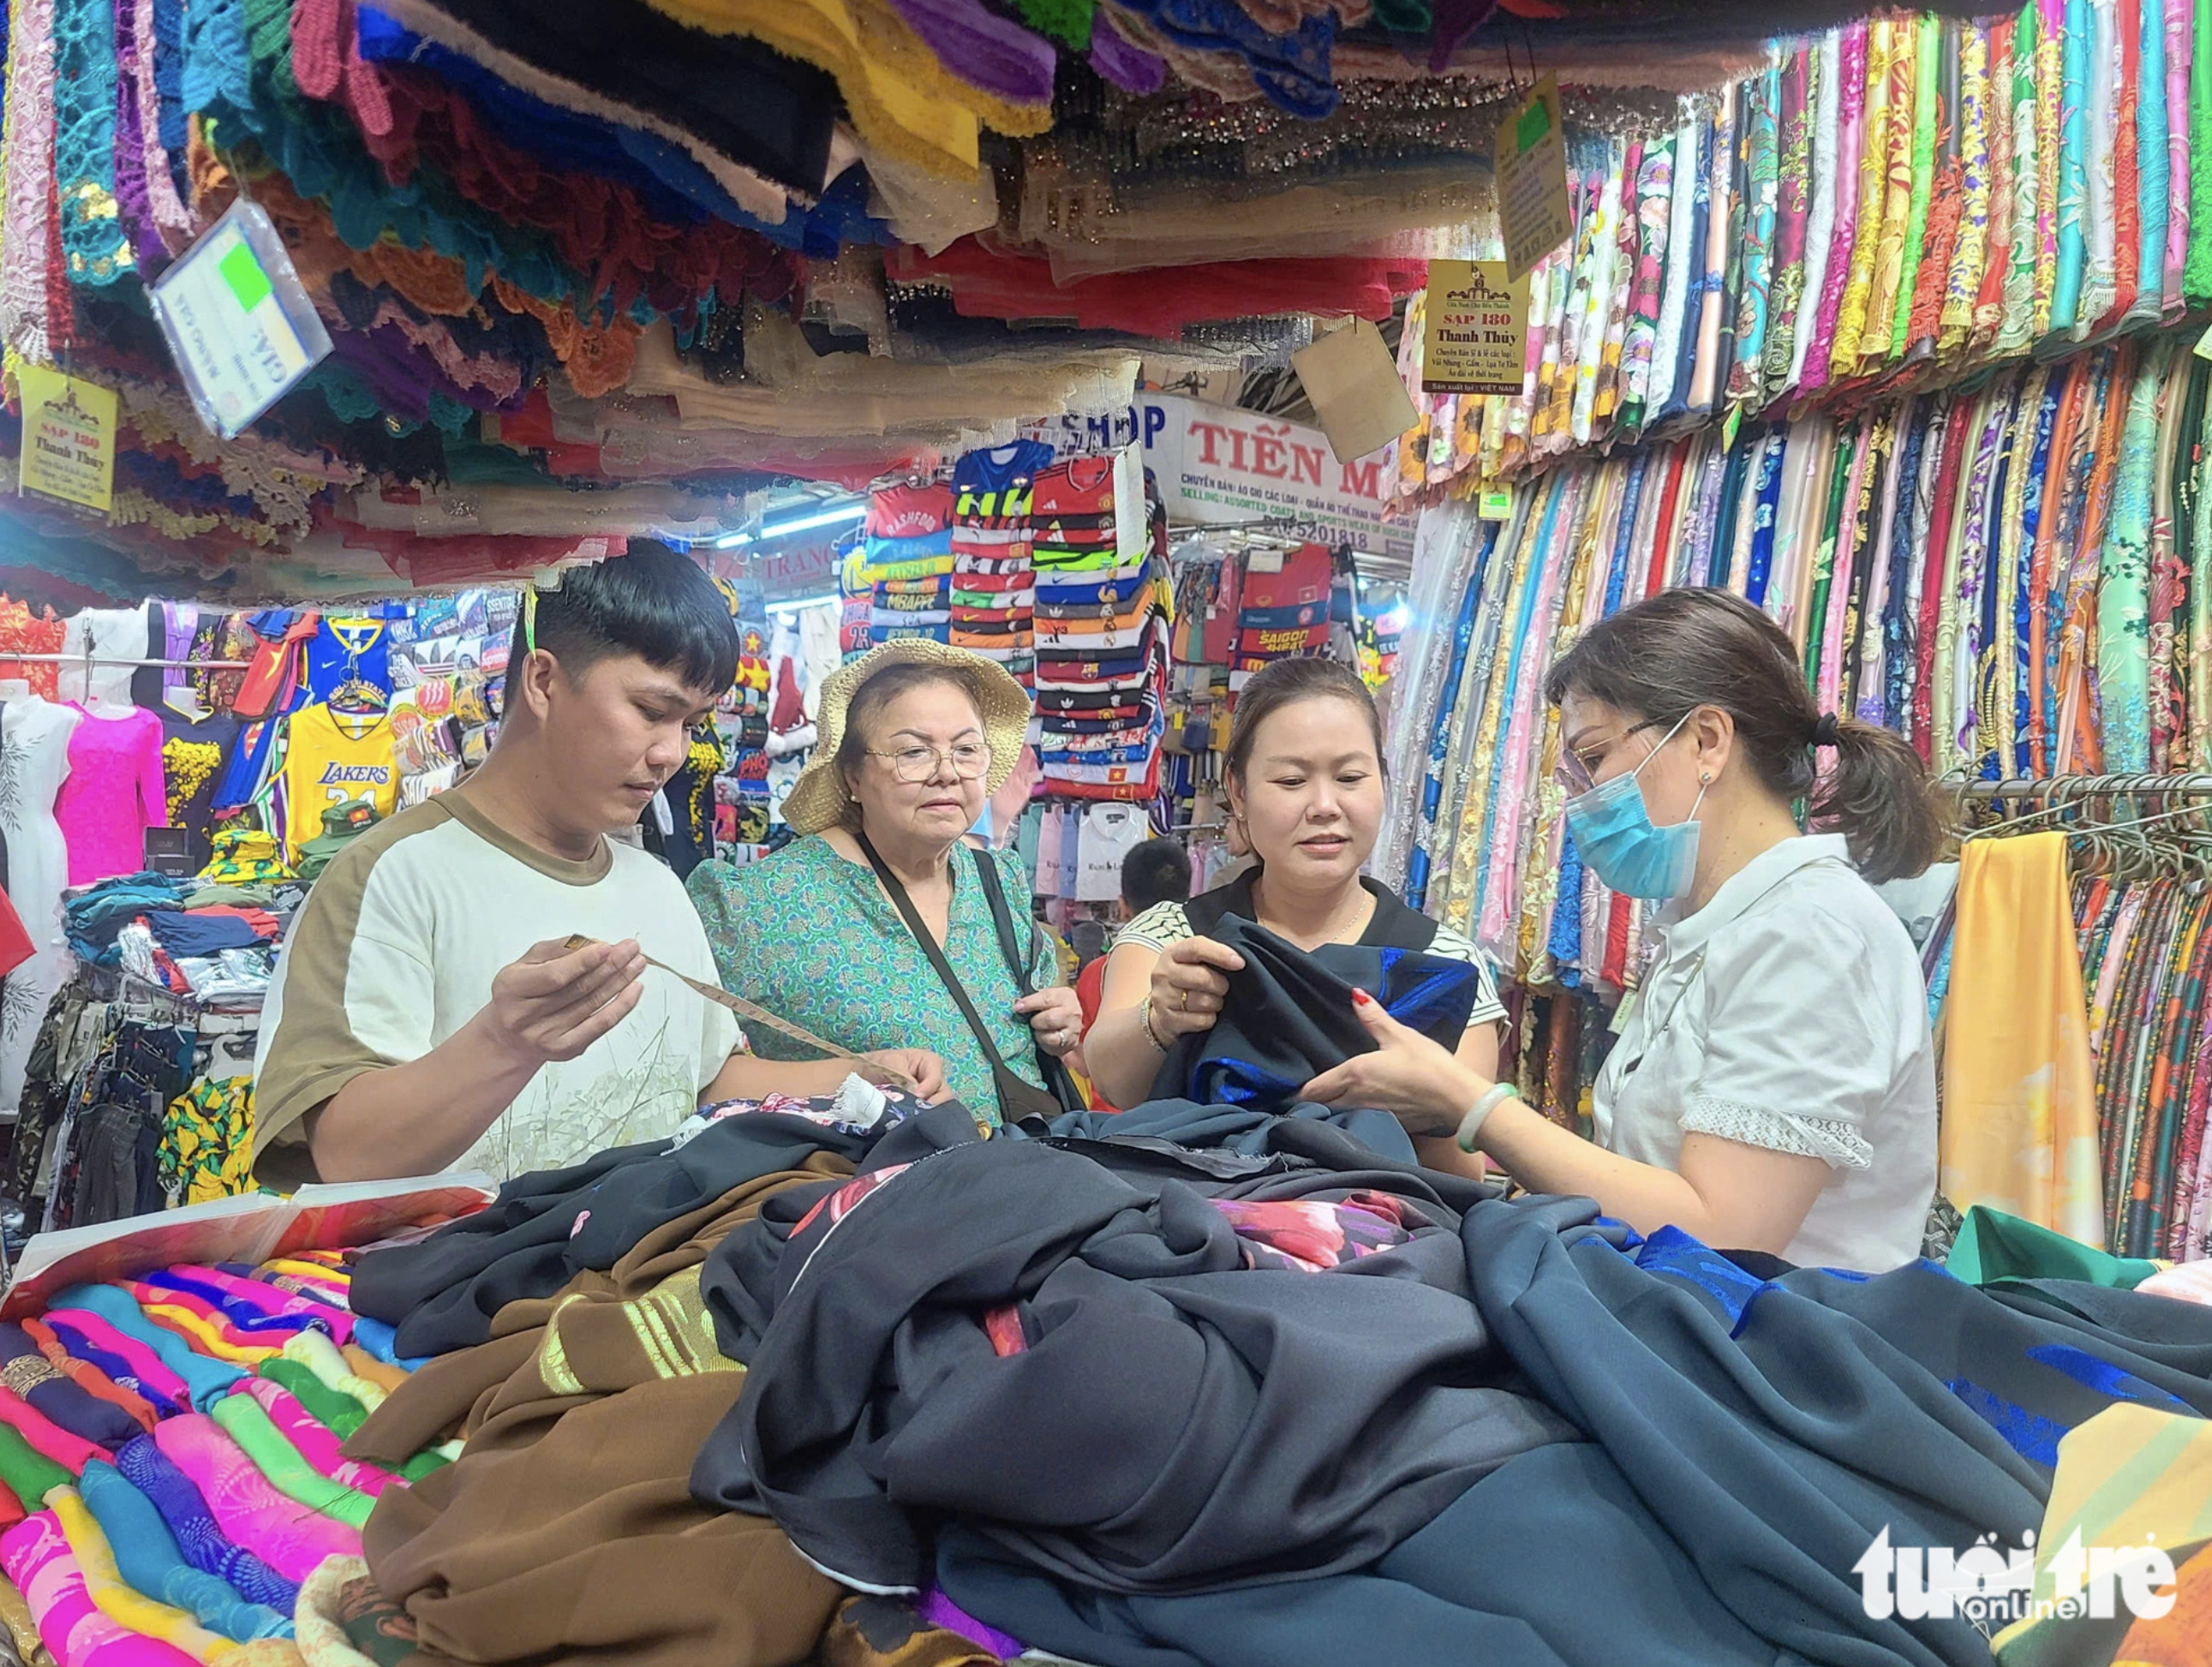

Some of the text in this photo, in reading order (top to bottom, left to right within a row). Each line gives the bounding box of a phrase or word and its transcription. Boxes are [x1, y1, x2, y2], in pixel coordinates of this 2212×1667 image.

[1443, 313, 1512, 327] SẠP 180
[1437, 329, 1480, 343] Thanh
[35, 435, 72, 459] Thanh
[1187, 419, 1325, 487] TIẾN
[1181, 473, 1215, 488] CHUYÊN
[1264, 489, 1279, 502] CÁC
[1181, 487, 1223, 504] SELLING:
[1224, 495, 1267, 513] ASSORTED
[1270, 505, 1295, 518] COATS
[1299, 510, 1314, 520] AND
[1318, 514, 1347, 528] SPORTS
[1348, 519, 1370, 533] WEAR
[851, 626, 870, 651] 23
[1258, 629, 1310, 644] SAIGON
[316, 761, 390, 786] LAKERS
